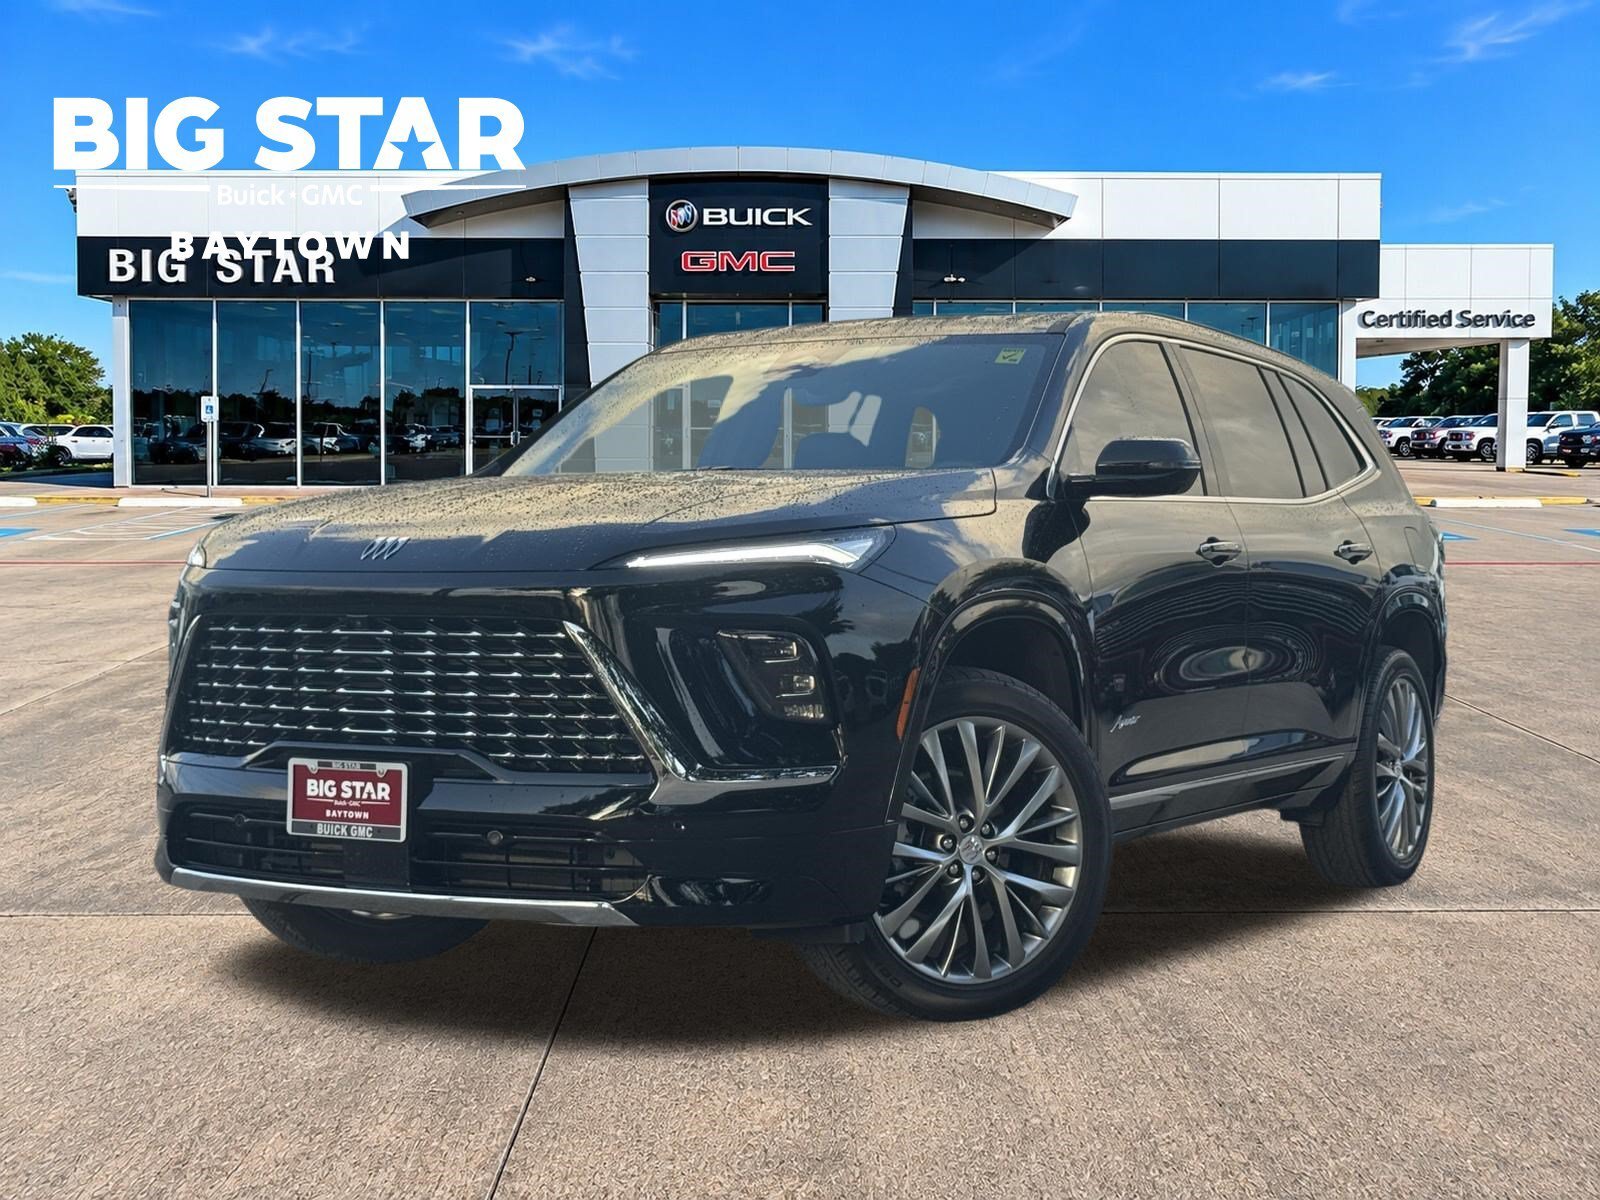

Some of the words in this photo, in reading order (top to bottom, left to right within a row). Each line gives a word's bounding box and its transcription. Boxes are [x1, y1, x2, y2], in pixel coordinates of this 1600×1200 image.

[702, 207, 814, 227] BUICK
[108, 248, 188, 283] BIG
[215, 247, 336, 284] STAR
[681, 250, 796, 272] GMC
[1359, 309, 1453, 328] Certified
[1455, 309, 1536, 328] Service
[306, 778, 338, 798] BIG
[340, 780, 391, 801] STAR
[325, 809, 370, 820] BAYTOWN
[316, 823, 349, 837] BUICK
[350, 825, 374, 838] GMC
